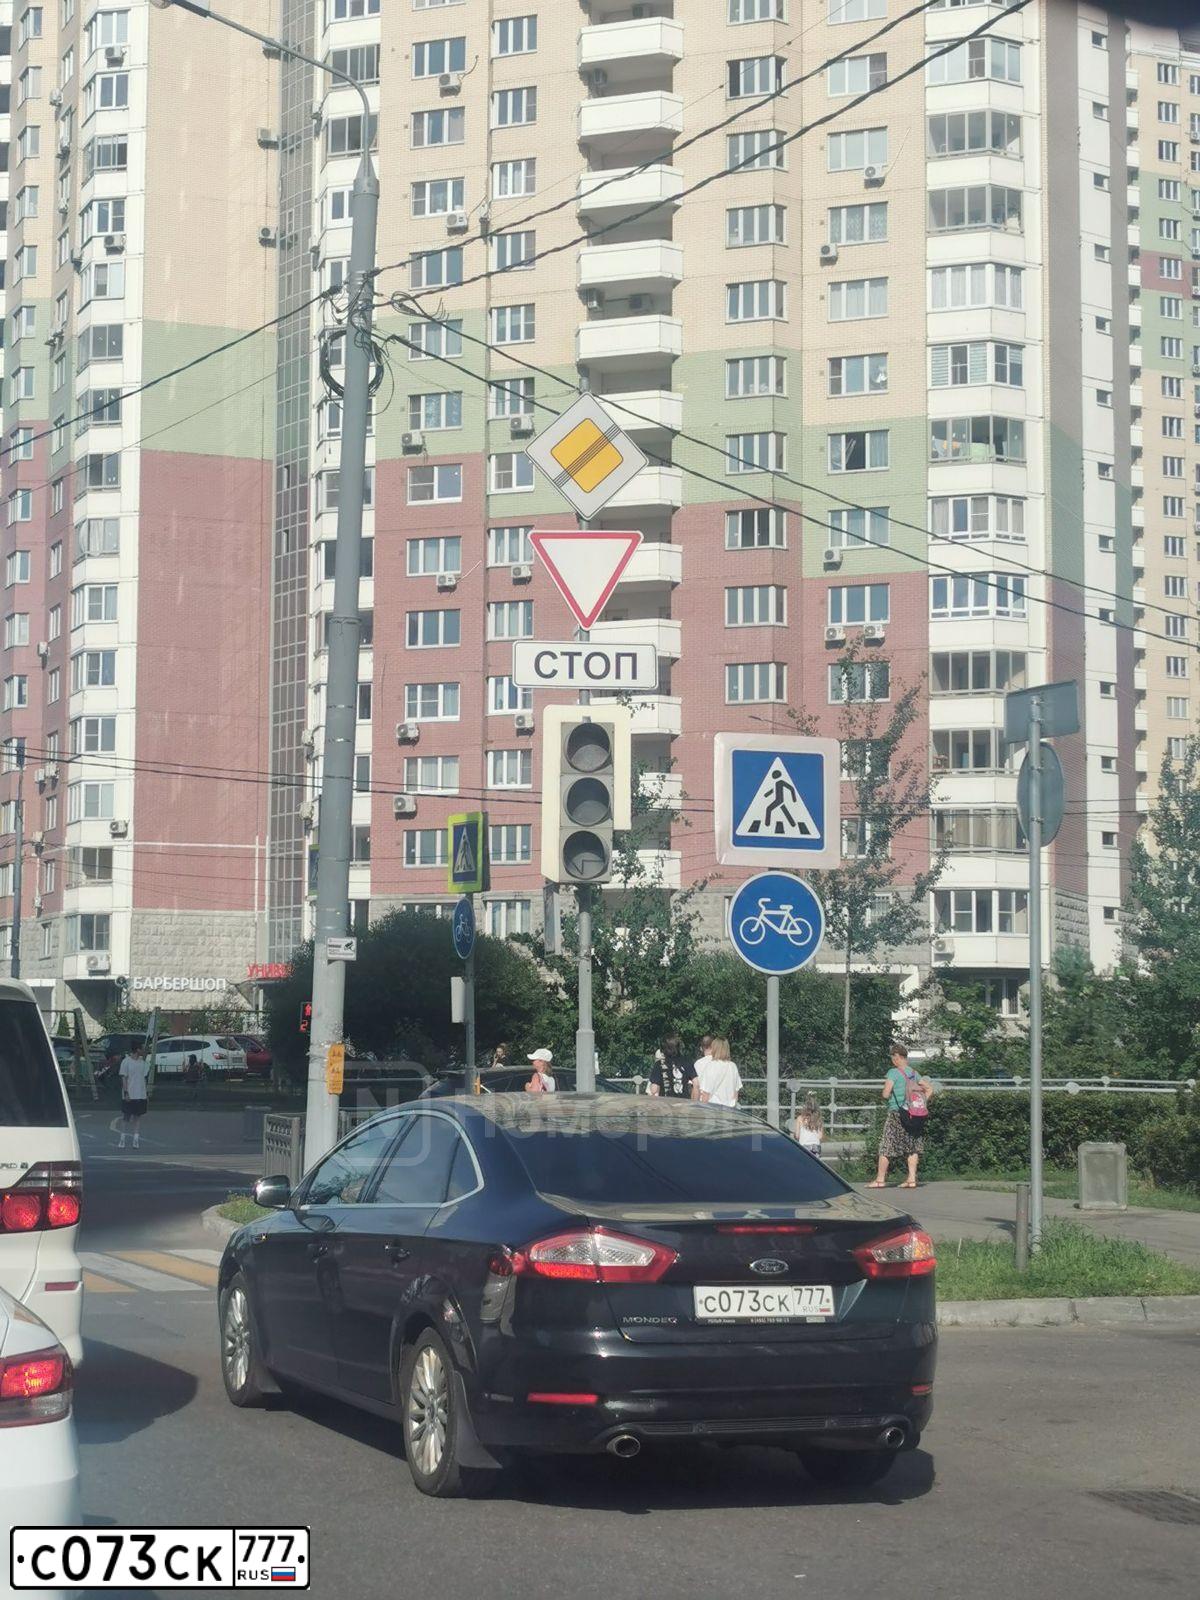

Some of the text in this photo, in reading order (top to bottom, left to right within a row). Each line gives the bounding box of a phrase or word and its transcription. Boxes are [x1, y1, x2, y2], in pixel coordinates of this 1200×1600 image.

[534, 650, 638, 680] СТОП
[132, 976, 227, 991] БАРБЕРШОП
[794, 1287, 825, 1305] 777
[622, 1316, 678, 1324] MONDEO
